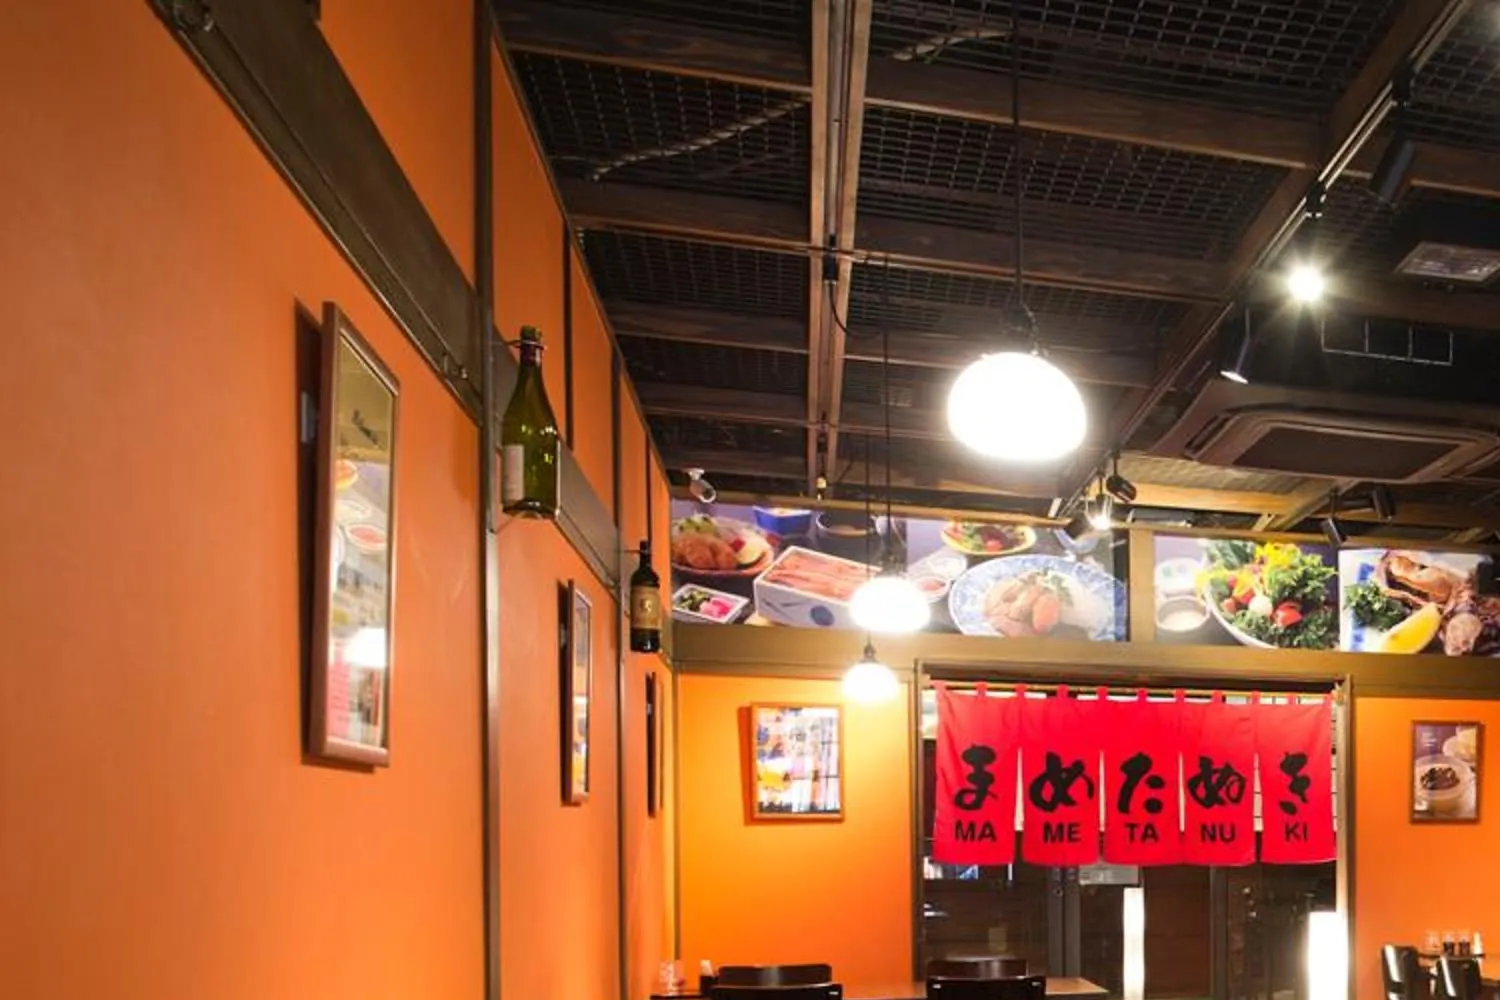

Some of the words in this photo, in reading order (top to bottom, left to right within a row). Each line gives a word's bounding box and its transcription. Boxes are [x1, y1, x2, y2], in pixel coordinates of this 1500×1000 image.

[954, 821, 997, 842] MA
[1043, 823, 1081, 842] ME
[1123, 823, 1159, 842] TA
[1201, 824, 1236, 843] NU
[1285, 823, 1308, 841] KI
